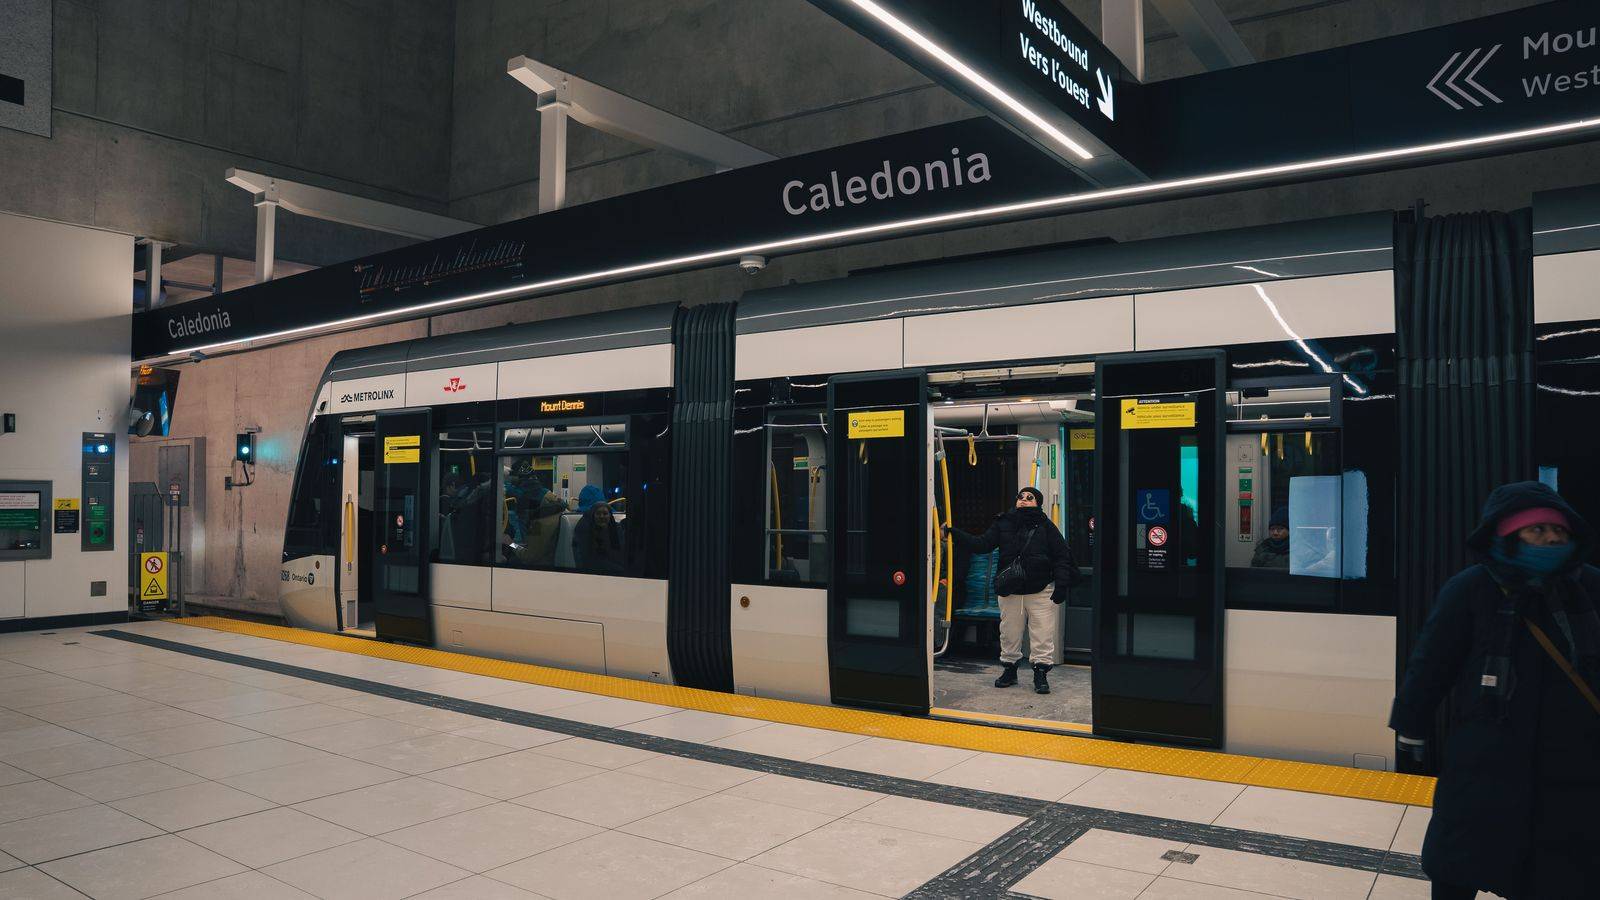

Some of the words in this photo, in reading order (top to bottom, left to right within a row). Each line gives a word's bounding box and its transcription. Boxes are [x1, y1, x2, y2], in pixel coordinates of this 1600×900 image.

[1022, 0, 1088, 71] Westbound
[1523, 27, 1596, 60] Mou
[1020, 32, 1049, 75] Vers
[1051, 58, 1090, 110] l'ouest
[1522, 65, 1600, 98] West
[782, 147, 992, 215] Caledonia
[168, 307, 231, 338] Caledonia
[353, 389, 394, 402] METROLINX
[540, 400, 561, 412] Mount
[561, 399, 585, 411] Dennis
[291, 573, 307, 583] Ontario
